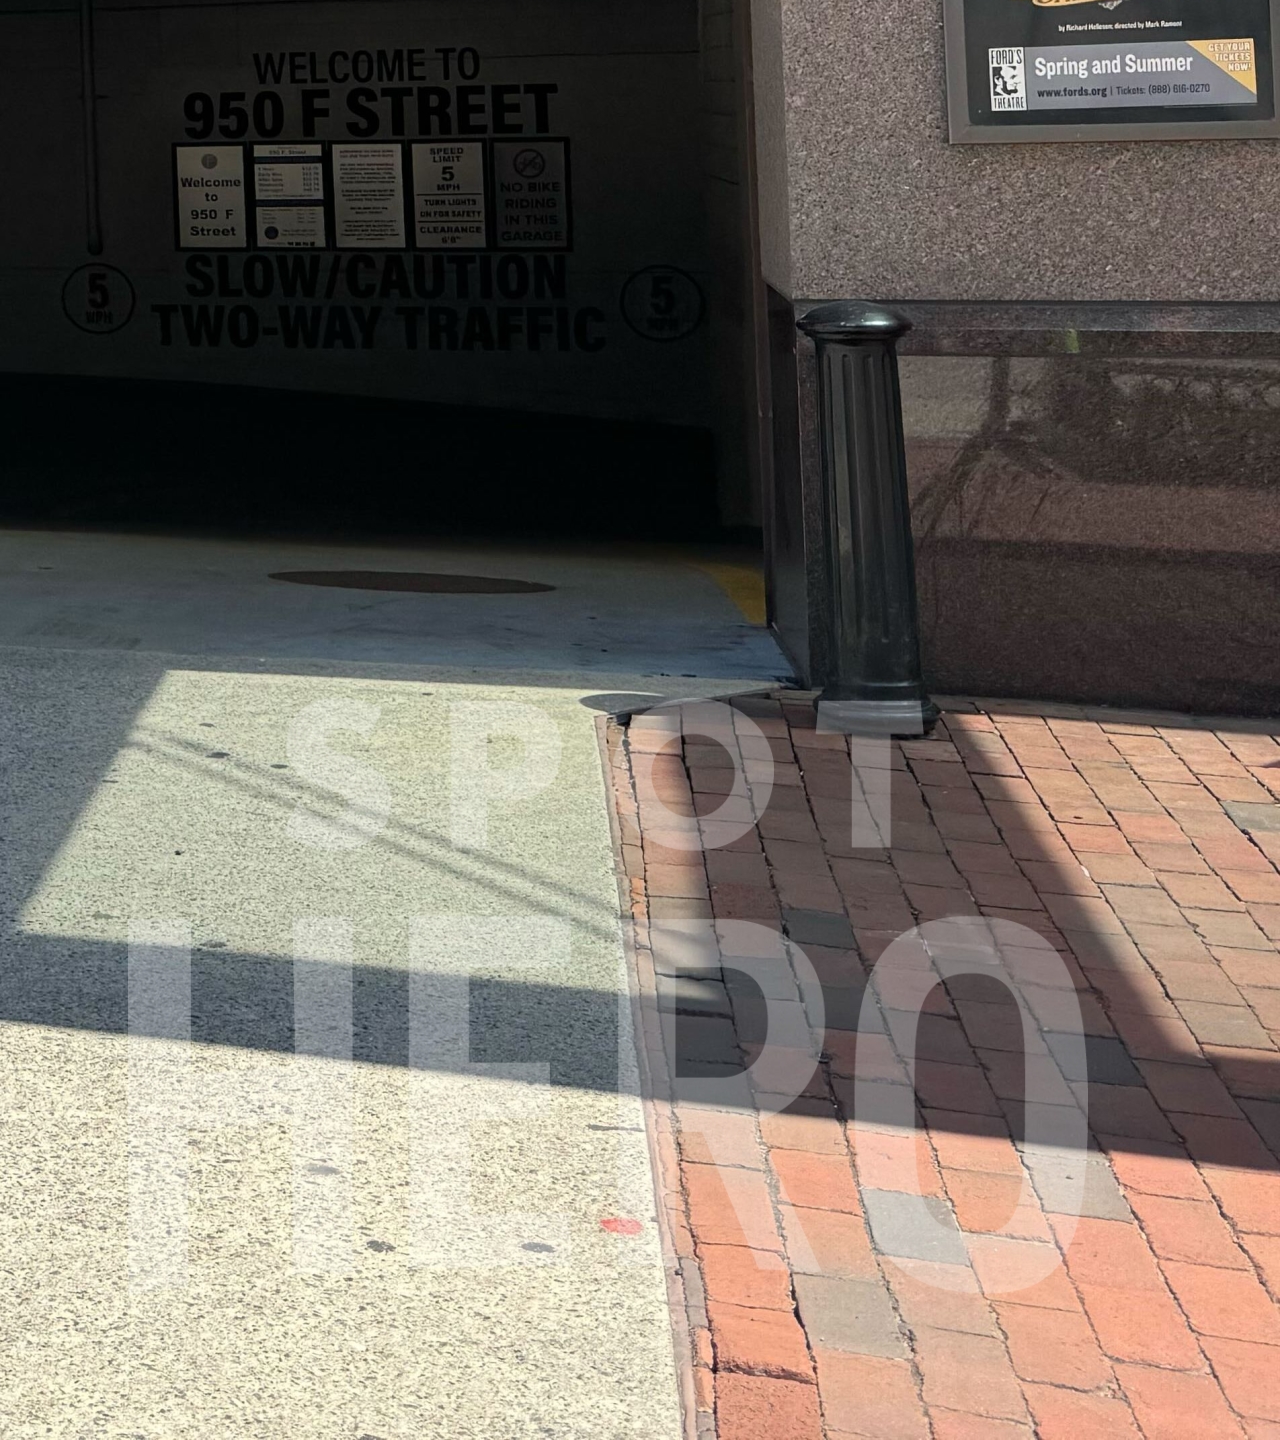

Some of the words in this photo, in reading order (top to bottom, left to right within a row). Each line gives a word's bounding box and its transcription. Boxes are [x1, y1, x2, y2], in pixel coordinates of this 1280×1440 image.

[1208, 43, 1225, 51] GET
[1227, 42, 1250, 51] YOUR
[991, 49, 1023, 65] FORD'S
[1214, 52, 1251, 60] TICKETS
[252, 49, 427, 85] WELCOME
[435, 47, 480, 81] TO
[1035, 57, 1088, 79] Spring
[1092, 59, 1121, 74] and
[1125, 55, 1193, 72] Summer
[1228, 63, 1252, 72] NOW!
[1037, 86, 1107, 99] www.fords.org
[1116, 86, 1146, 96] Tickets:
[1149, 84, 1170, 95] (888)
[1173, 83, 1211, 94] 616-0270
[994, 97, 1025, 109] THEATRE
[183, 91, 285, 139] 950
[302, 90, 330, 137] F
[346, 83, 559, 137] STREET
[429, 147, 464, 155] SPEED
[441, 166, 454, 181] 5
[181, 178, 241, 187] Welcome
[500, 182, 522, 193] NO
[528, 182, 560, 192] BIKE
[205, 193, 218, 201] to
[506, 199, 557, 209] RIDING
[191, 210, 217, 219] 950
[226, 210, 233, 219] F
[506, 215, 521, 225] IN
[524, 215, 558, 225] THIS
[190, 226, 236, 236] Street
[501, 231, 563, 241] GARAGE
[185, 253, 566, 300] SLOW/CAUTION
[87, 274, 109, 308] 5
[650, 275, 674, 316] 5
[85, 311, 112, 324] MPH
[152, 304, 383, 349] TWO-WAY
[396, 306, 606, 352] TRAFFIC
